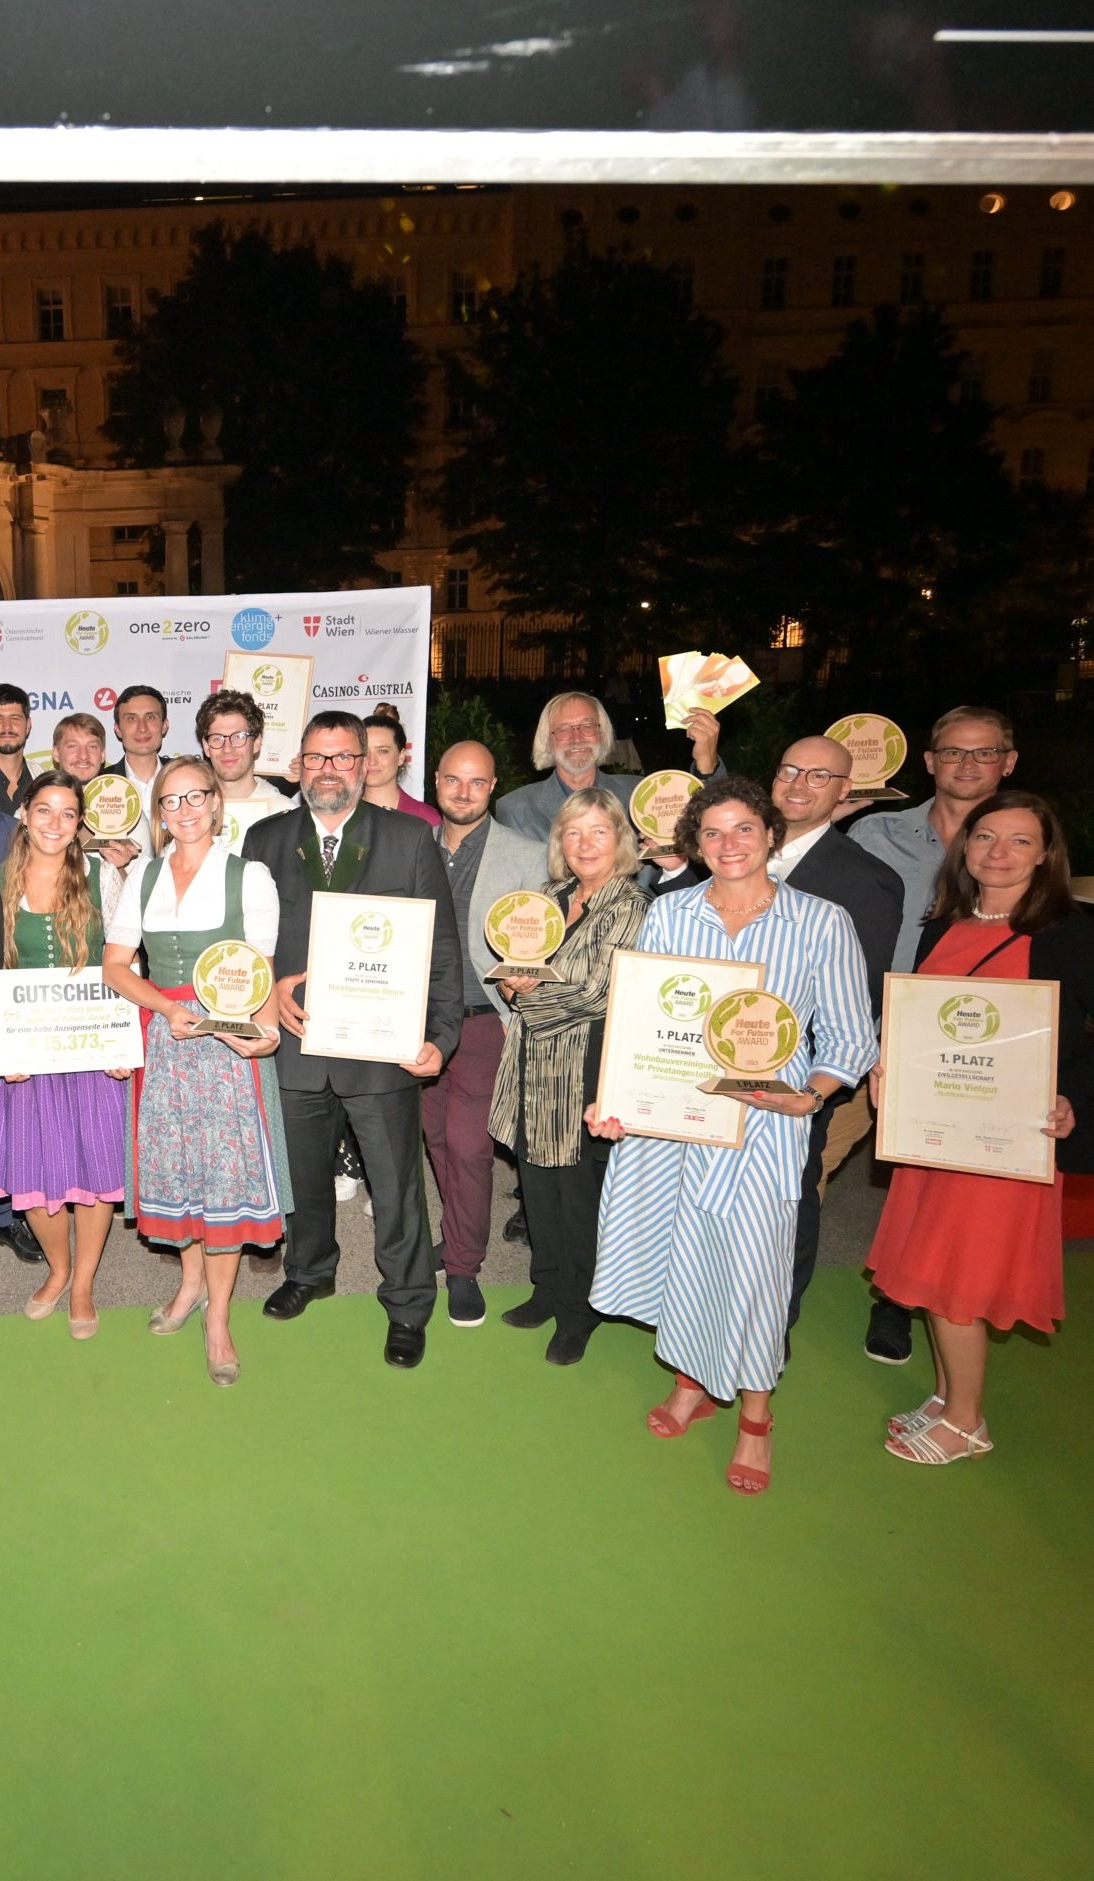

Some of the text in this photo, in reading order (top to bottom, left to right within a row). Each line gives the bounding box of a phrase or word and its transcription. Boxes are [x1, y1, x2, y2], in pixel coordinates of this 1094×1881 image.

[240, 613, 274, 623] klima
[326, 615, 355, 626] Stadt
[129, 620, 211, 634] one2zero
[231, 621, 274, 633] energie
[326, 627, 355, 637] Wien
[241, 631, 273, 642] fonds
[312, 682, 414, 698] CASINOS AUSTRIA
[257, 703, 279, 711] PLATZ
[847, 739, 879, 747] Heute
[852, 753, 878, 761] WARD
[654, 795, 684, 804] Heute
[509, 916, 539, 925] Heute
[218, 967, 248, 977] Heute
[348, 961, 388, 973] 2. PLATZ
[218, 983, 246, 992] AWARD
[328, 984, 380, 994] Marktgemeinde
[675, 989, 696, 997] Heute
[956, 1010, 982, 1018] Heute
[54, 1022, 101, 1033] Anzeigenseite
[110, 1020, 131, 1029] Heute
[735, 1018, 771, 1029] Heute
[656, 1029, 703, 1044] 1. PLATZ
[746, 1029, 775, 1037] Future
[736, 1037, 769, 1046] AWARD
[658, 1047, 696, 1057] UNTERNEHMEN
[633, 1052, 719, 1071] Wohnbauvereinigung
[940, 1054, 994, 1067] 1. PLATZ
[633, 1062, 646, 1071] für
[937, 1072, 995, 1082] ZIVILGESELLSCHAFT
[744, 1081, 771, 1089] PLATZ
[933, 1080, 961, 1091] Mario
